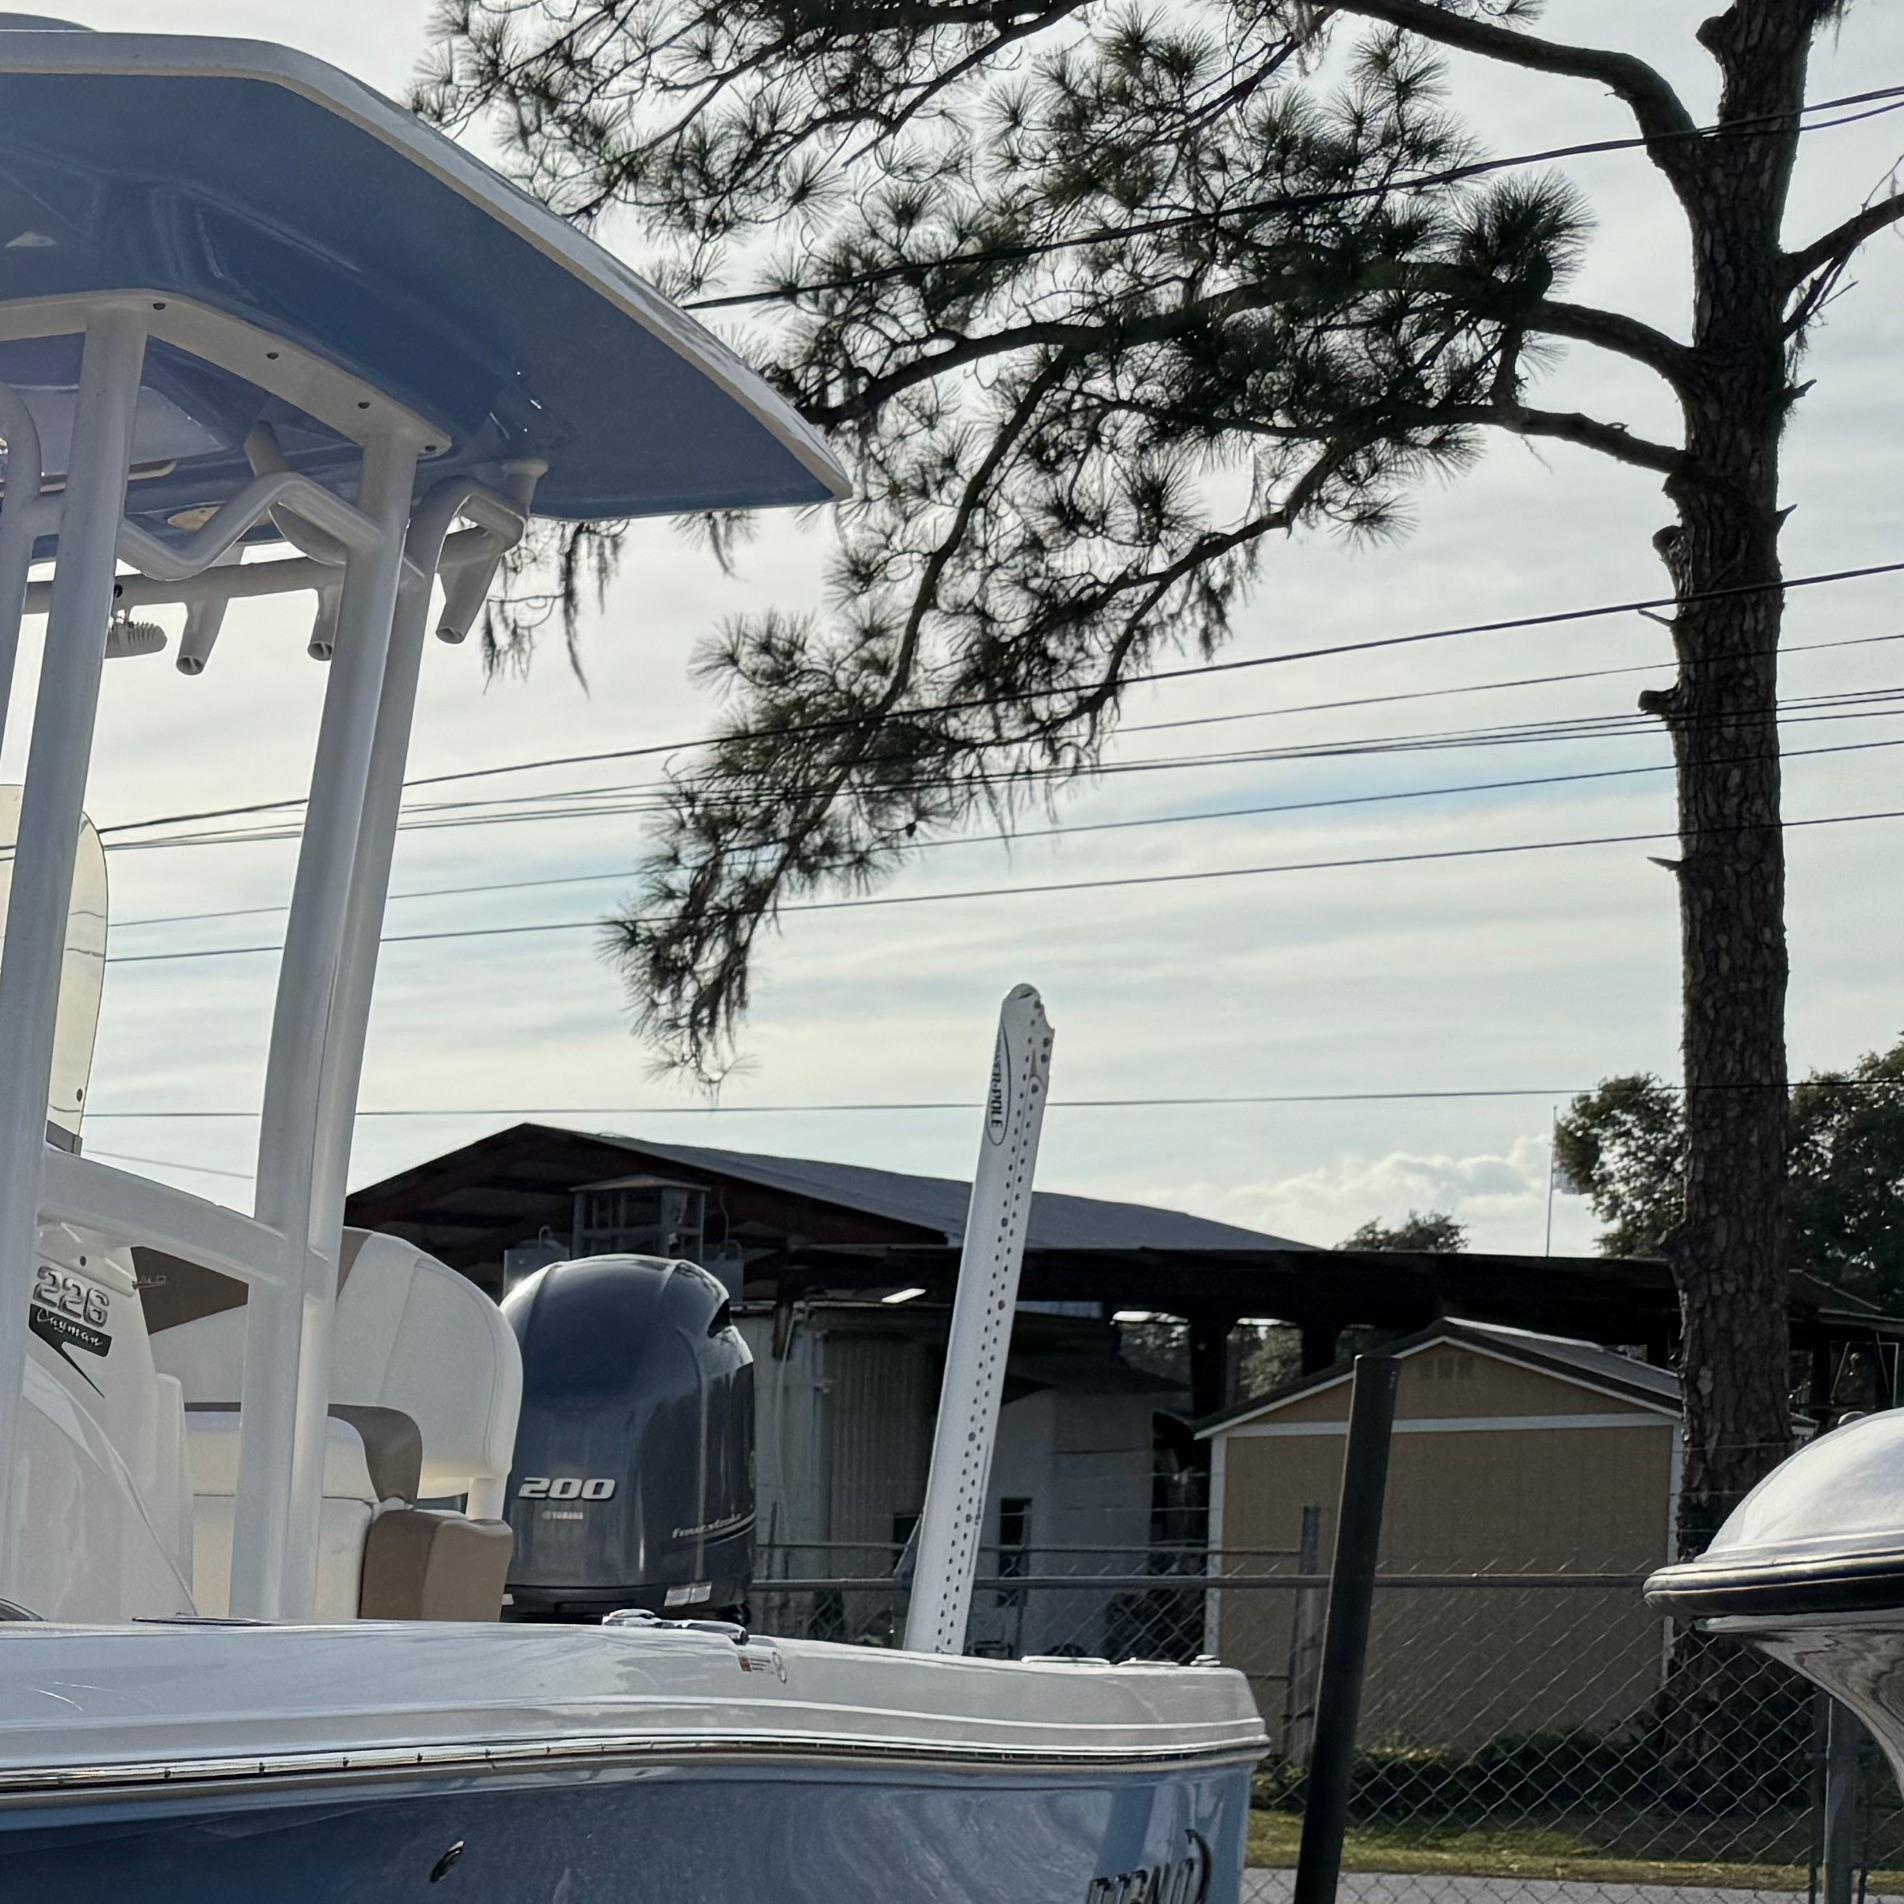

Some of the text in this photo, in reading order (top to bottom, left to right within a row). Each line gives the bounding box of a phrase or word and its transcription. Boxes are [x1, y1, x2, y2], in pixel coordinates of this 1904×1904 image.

[33, 1266, 109, 1327] 226
[36, 1307, 103, 1346] Cayman
[518, 1477, 616, 1500] 200
